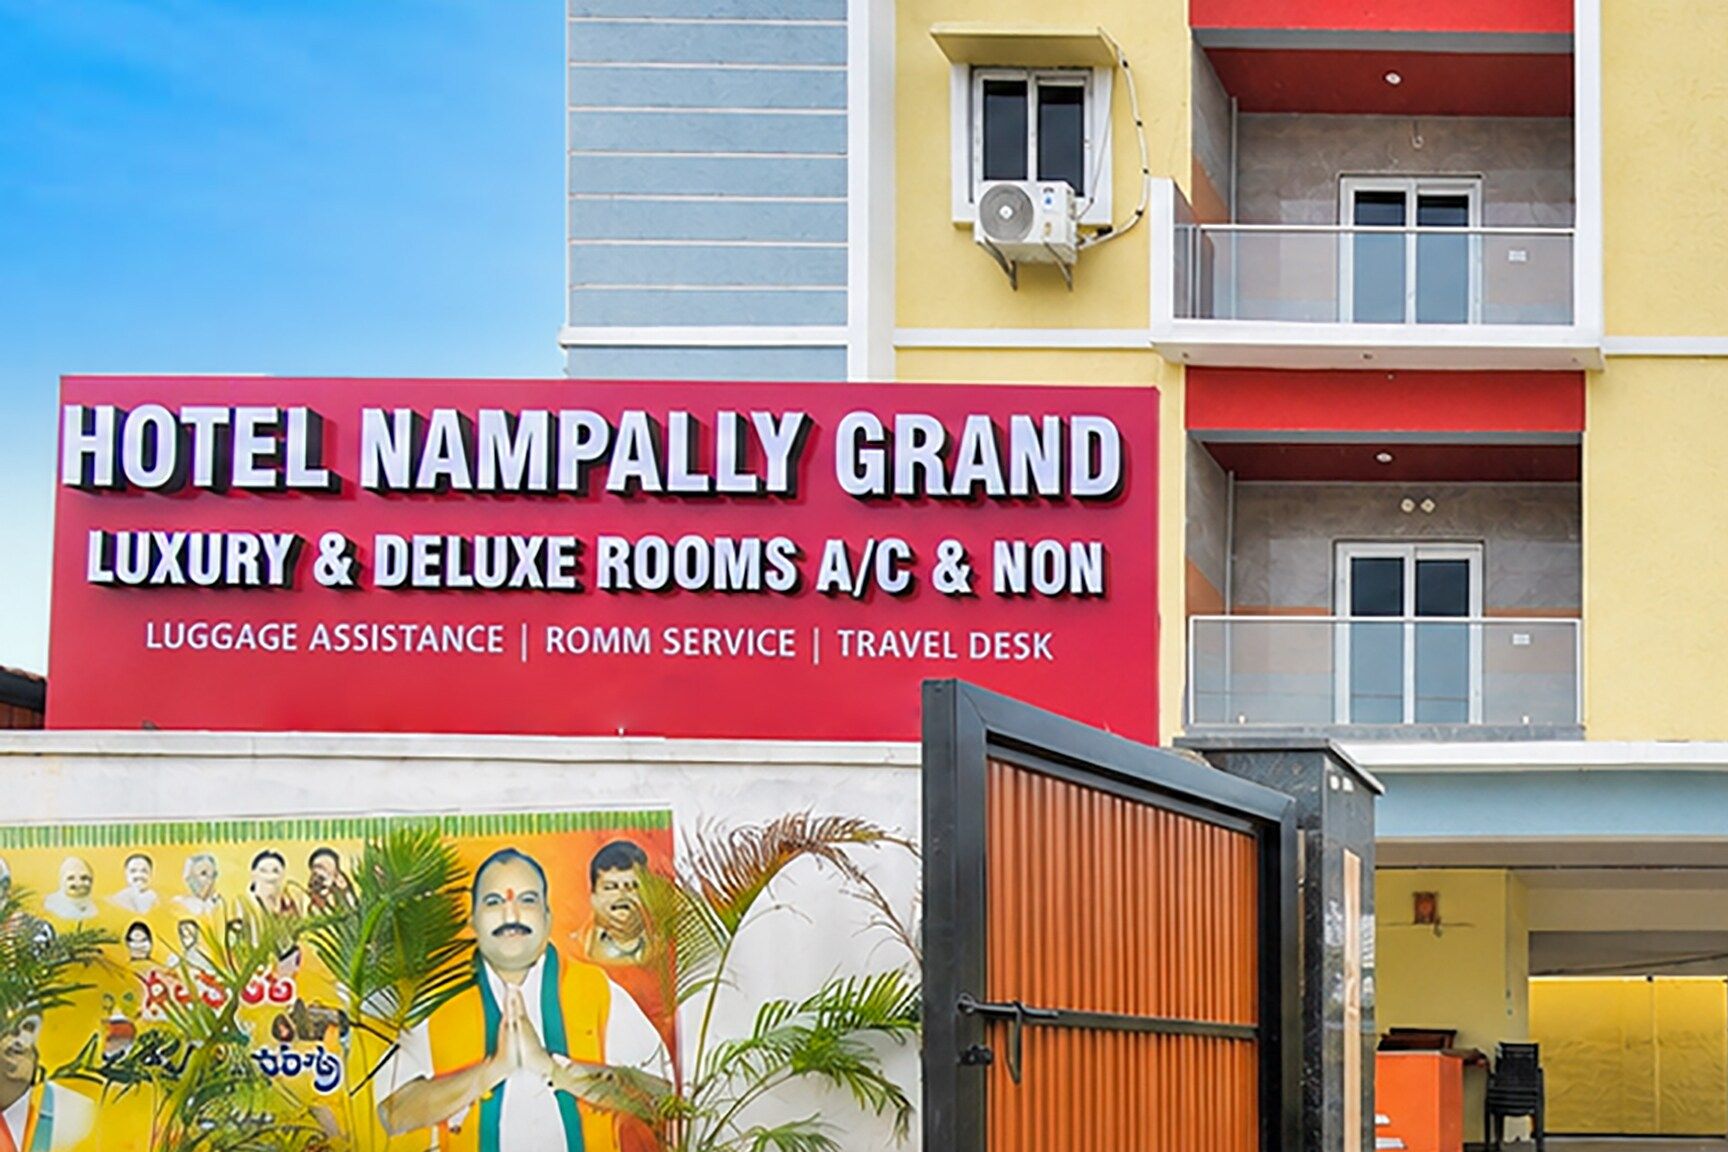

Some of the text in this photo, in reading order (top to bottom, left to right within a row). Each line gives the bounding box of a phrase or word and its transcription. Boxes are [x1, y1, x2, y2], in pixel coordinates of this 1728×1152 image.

[62, 403, 1123, 498] HOTEL NAMPALLY GRAND
[87, 529, 1105, 598] LUXURY & DELUXE ROOMS A/C & NON
[146, 621, 1054, 661] LUGGAGE ASSISTANCE ROMM SERVICE TRAVEL DESK
